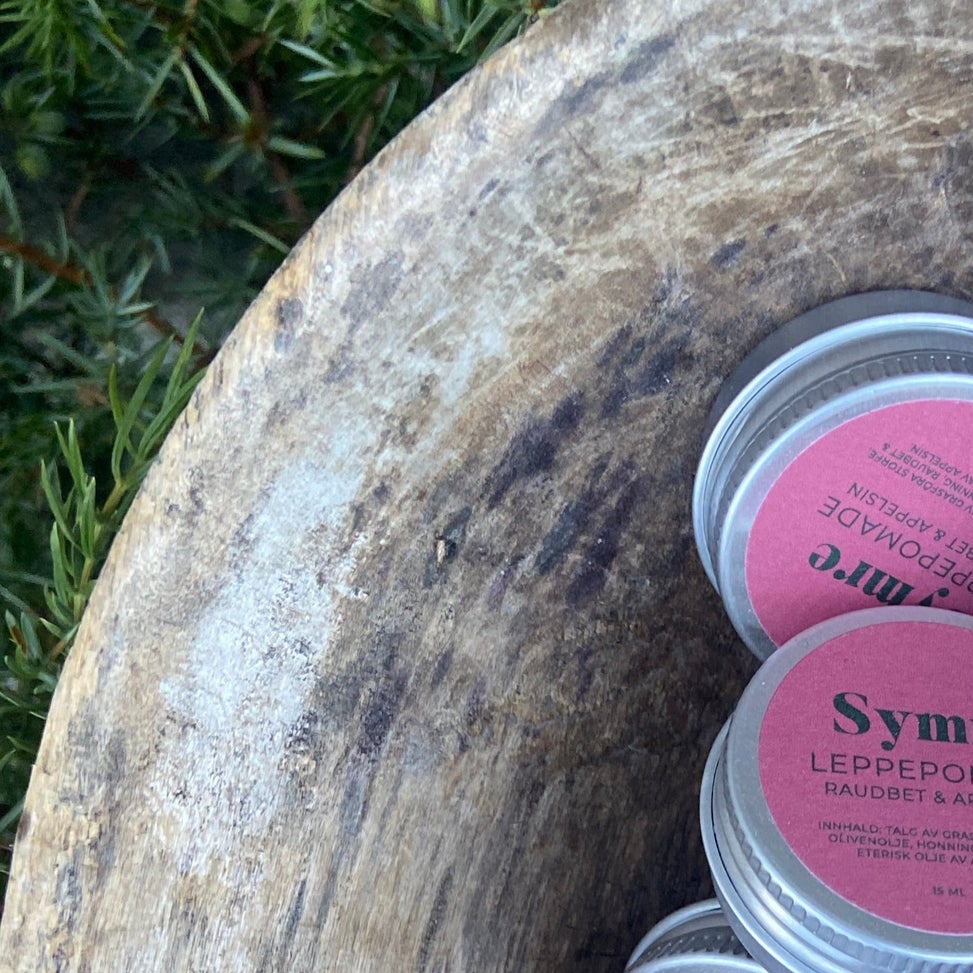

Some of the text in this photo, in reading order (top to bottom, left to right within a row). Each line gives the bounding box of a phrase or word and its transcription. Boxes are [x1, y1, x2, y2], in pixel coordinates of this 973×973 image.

[846, 482, 934, 533] APPELSIN
[933, 527, 946, 542] &
[808, 543, 950, 607] ymre
[824, 781, 927, 803] RAUDBET
[933, 790, 946, 804] &
[884, 824, 918, 836] TALG
[921, 828, 938, 838] AV
[857, 847, 911, 860] ETERISK
[913, 851, 946, 863] OLJE
[949, 854, 967, 864] AV
[932, 884, 966, 897] 15 ML
